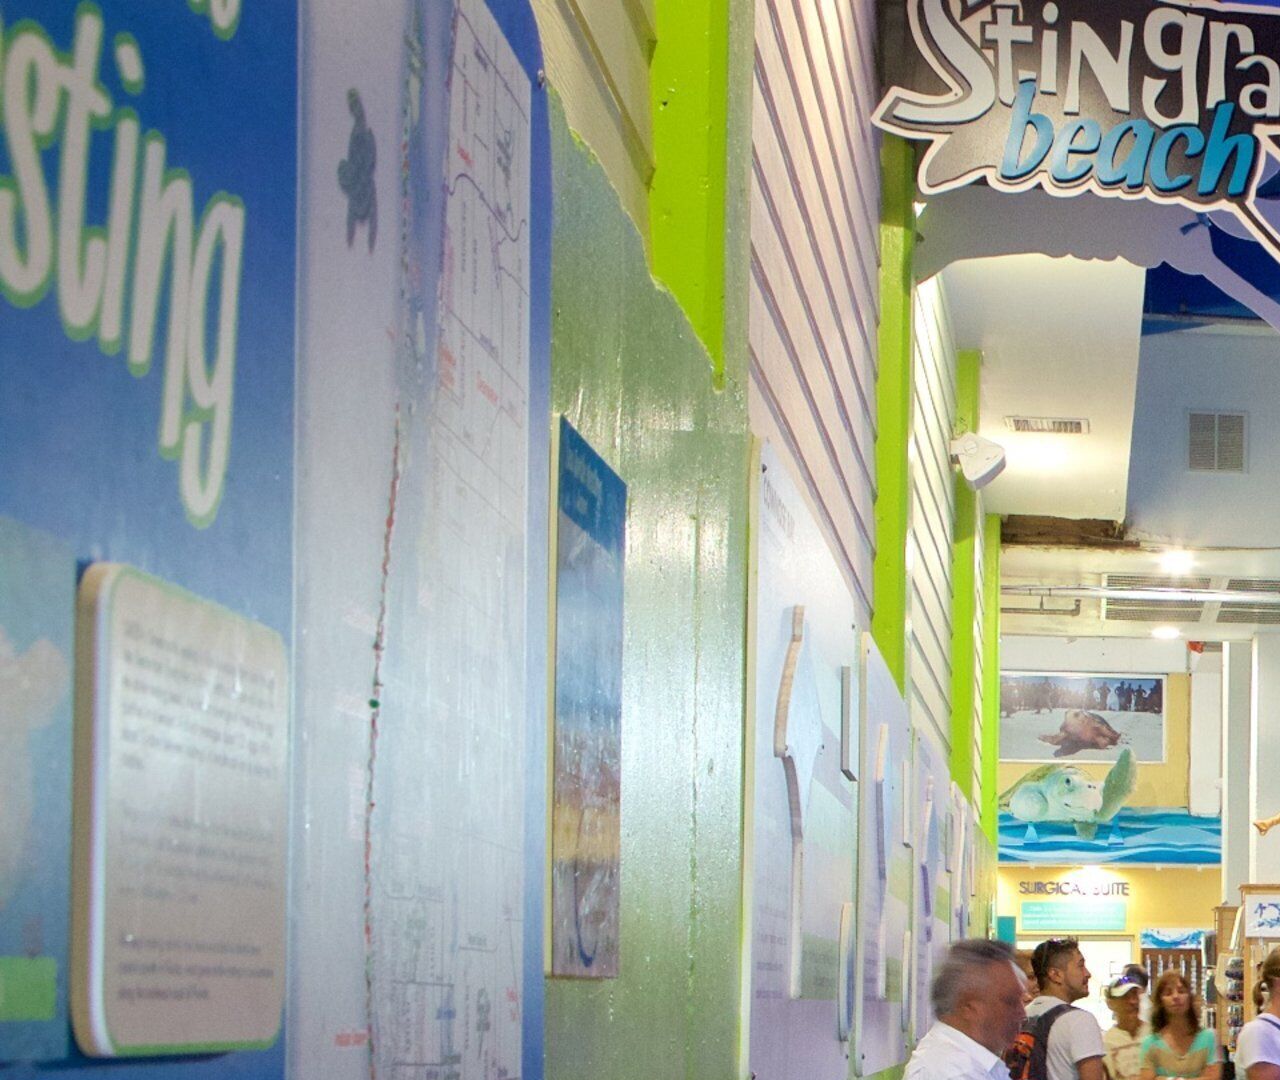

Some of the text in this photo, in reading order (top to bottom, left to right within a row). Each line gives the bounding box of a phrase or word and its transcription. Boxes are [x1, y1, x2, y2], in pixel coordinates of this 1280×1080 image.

[1000, 78, 1256, 196] beach
[1019, 881, 1130, 896] SURGICA UITE
